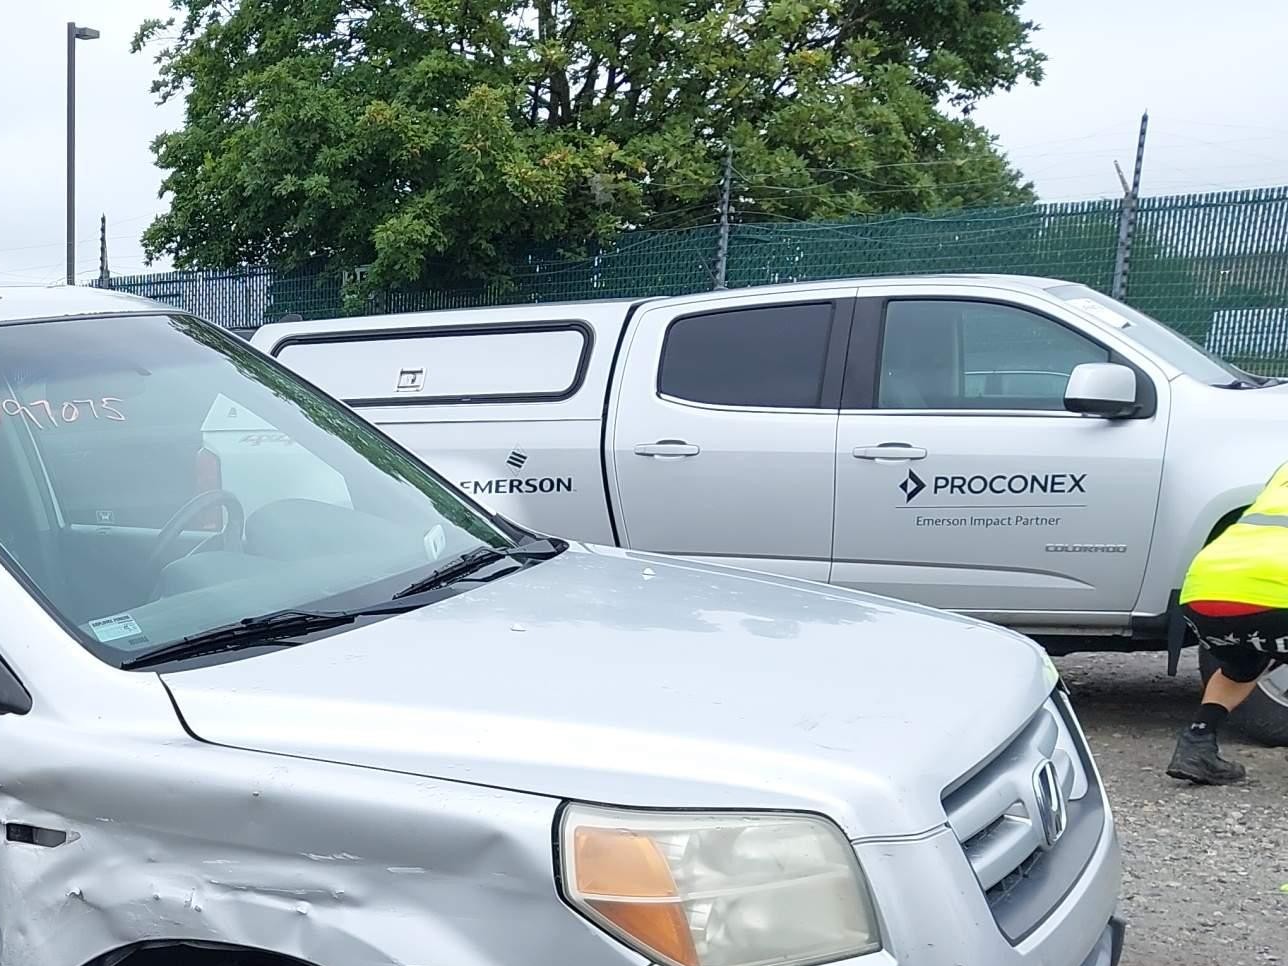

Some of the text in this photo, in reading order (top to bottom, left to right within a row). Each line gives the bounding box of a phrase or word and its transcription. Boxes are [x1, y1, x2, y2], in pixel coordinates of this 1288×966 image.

[933, 473, 1088, 495] PROCONEX
[916, 515, 1061, 529] Emerson Impact Partner
[1045, 543, 1128, 553] COLORADO
